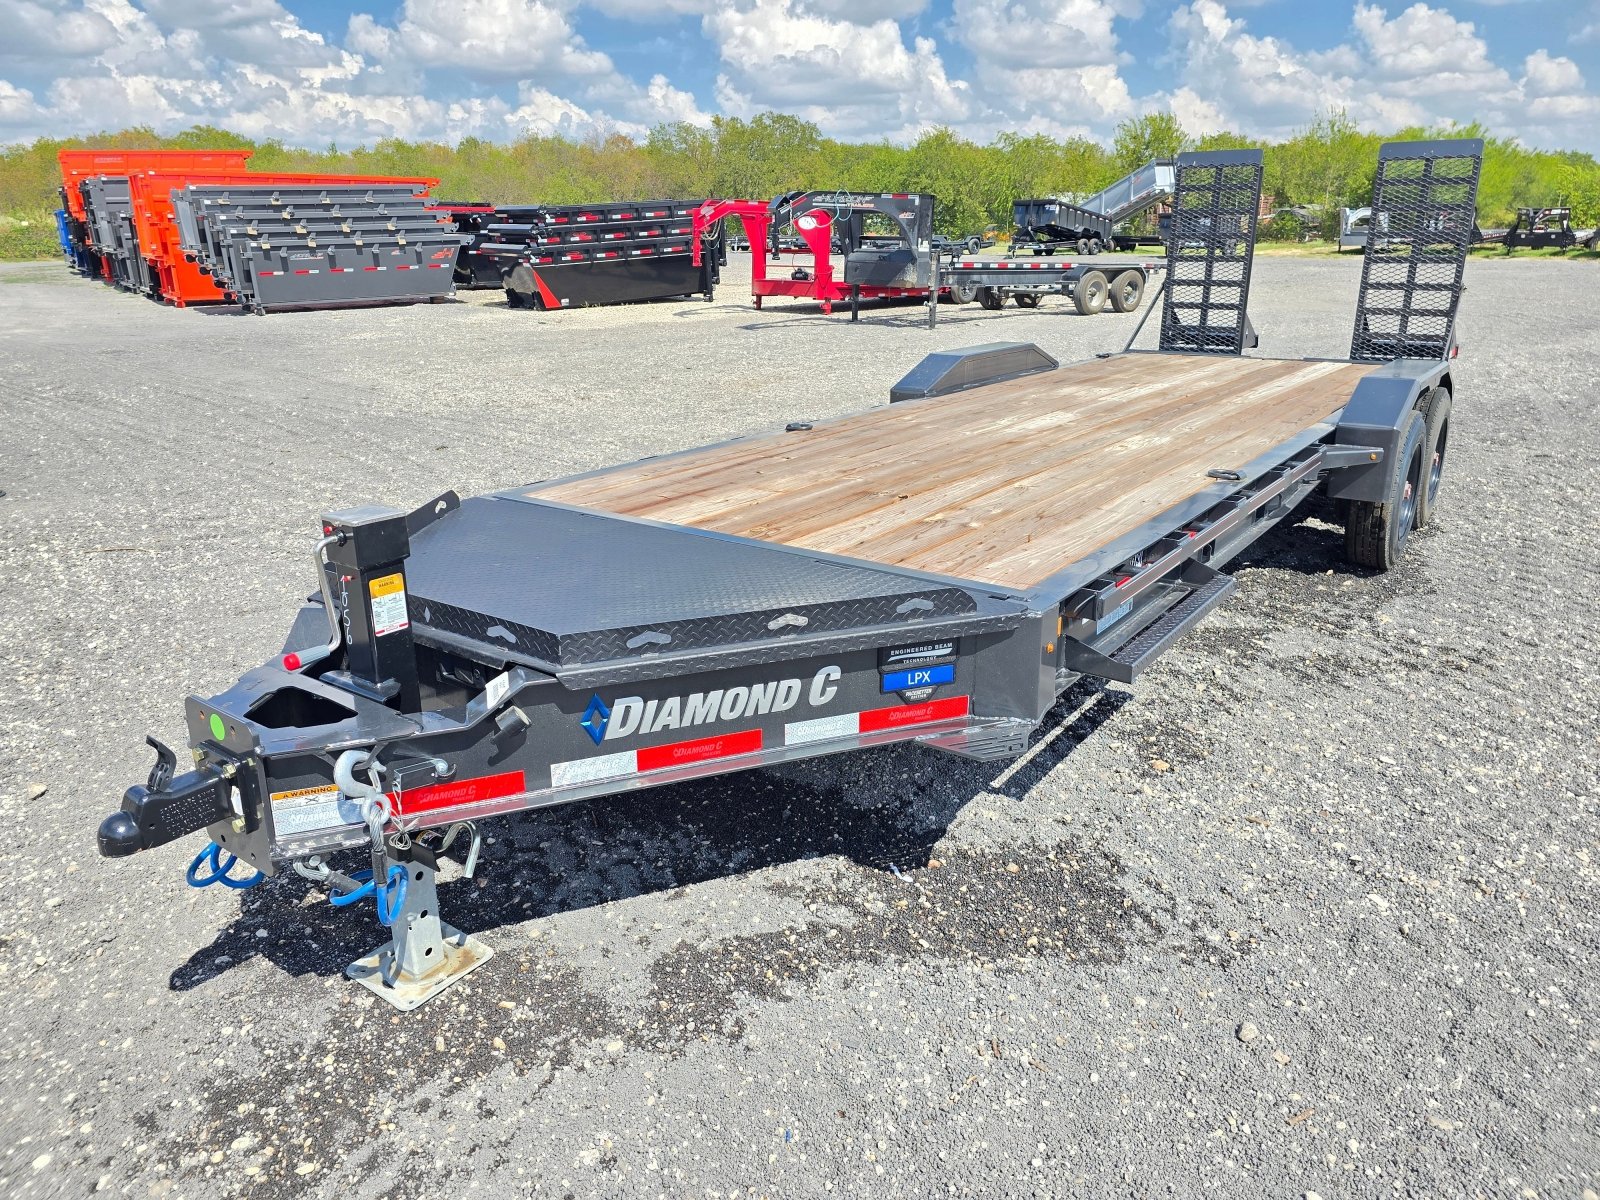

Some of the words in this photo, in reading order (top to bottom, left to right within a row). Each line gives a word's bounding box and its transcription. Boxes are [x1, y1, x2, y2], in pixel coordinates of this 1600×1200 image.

[890, 645, 933, 656] ENGINEERED
[934, 642, 953, 650] BEAM
[903, 656, 937, 664] TECHNOLOGY
[907, 670, 931, 685] LPX
[604, 678, 802, 741] DIAMOND
[808, 665, 842, 706] C
[892, 708, 926, 720] DIAMOND
[926, 706, 934, 714] C
[678, 744, 715, 757] DIAMOND
[715, 741, 723, 750] C
[291, 786, 333, 798] WARNING
[467, 785, 477, 795] C
